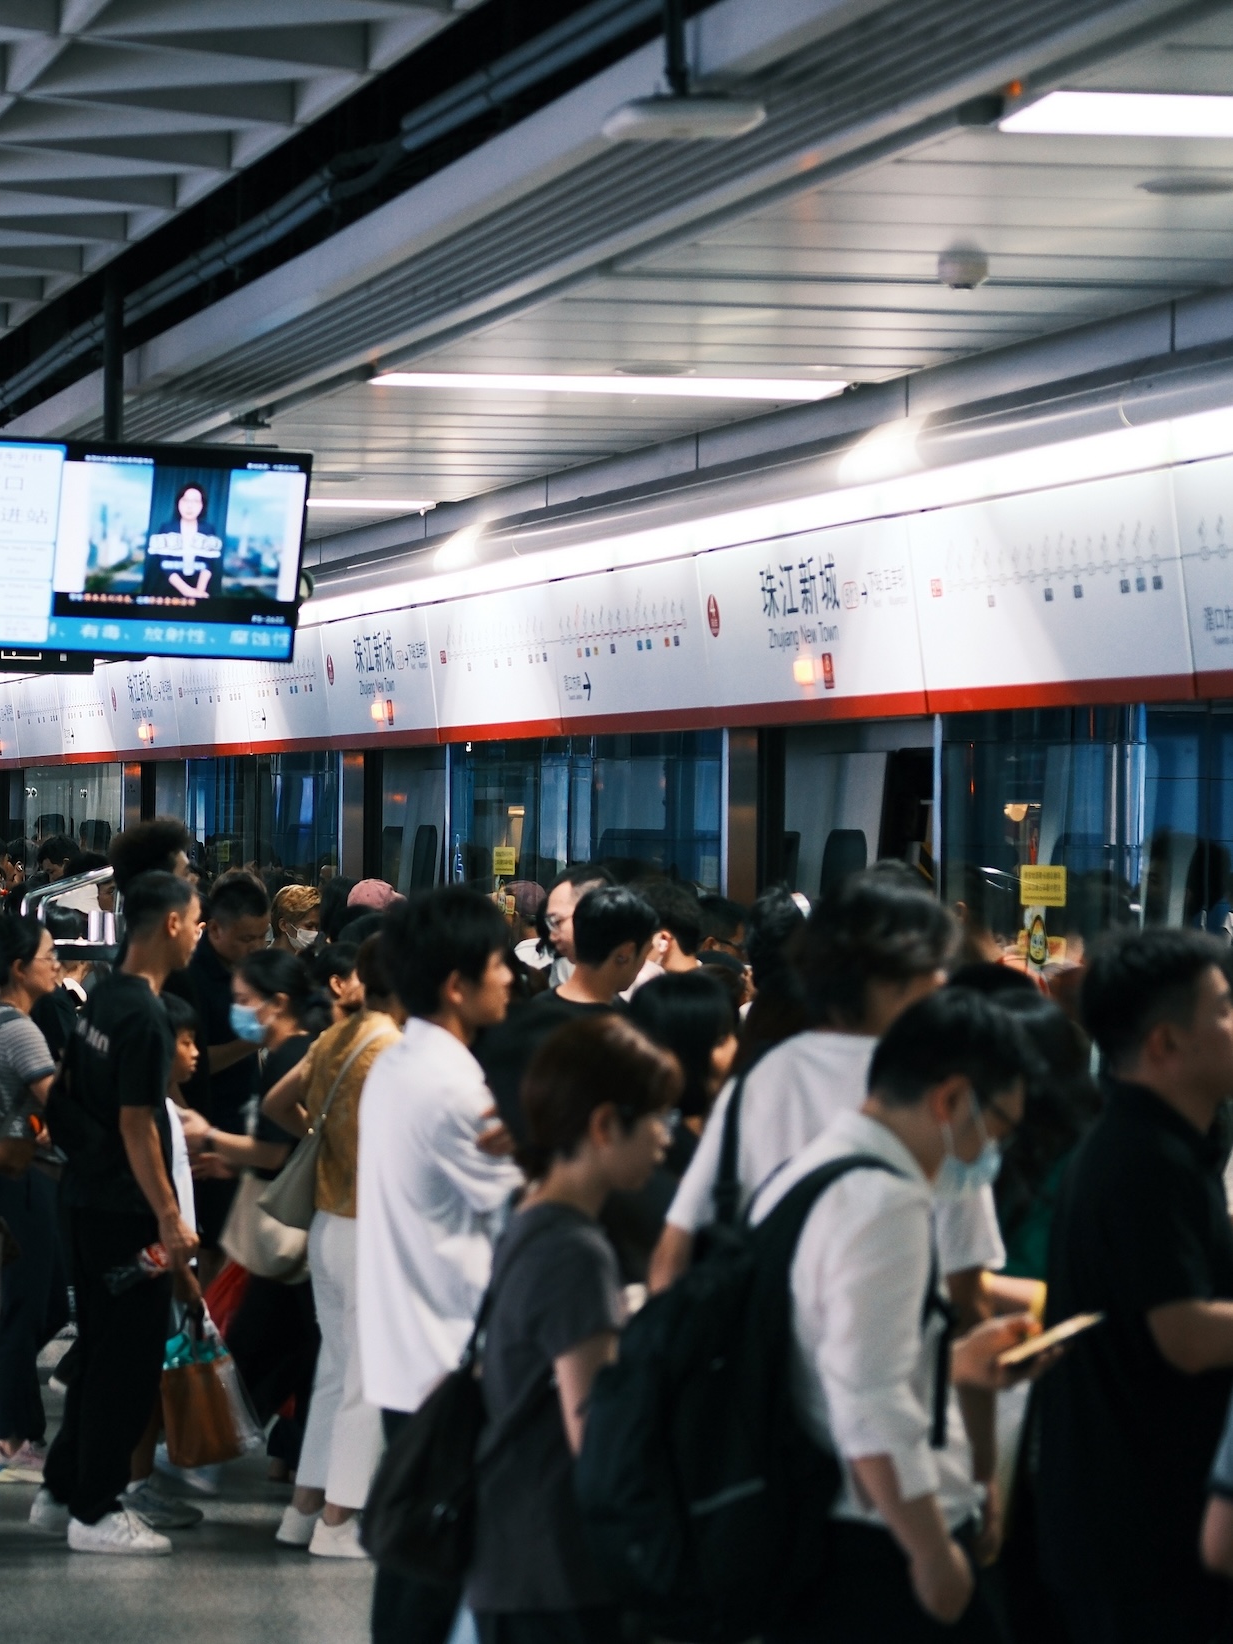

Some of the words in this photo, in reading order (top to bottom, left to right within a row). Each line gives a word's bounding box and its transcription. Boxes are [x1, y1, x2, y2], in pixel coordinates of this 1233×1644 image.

[759, 552, 840, 618] 珠江新城
[353, 629, 395, 674] 珠江新城
[768, 627, 800, 653] Zhujiang
[800, 625, 817, 644] New
[818, 622, 840, 642] Town
